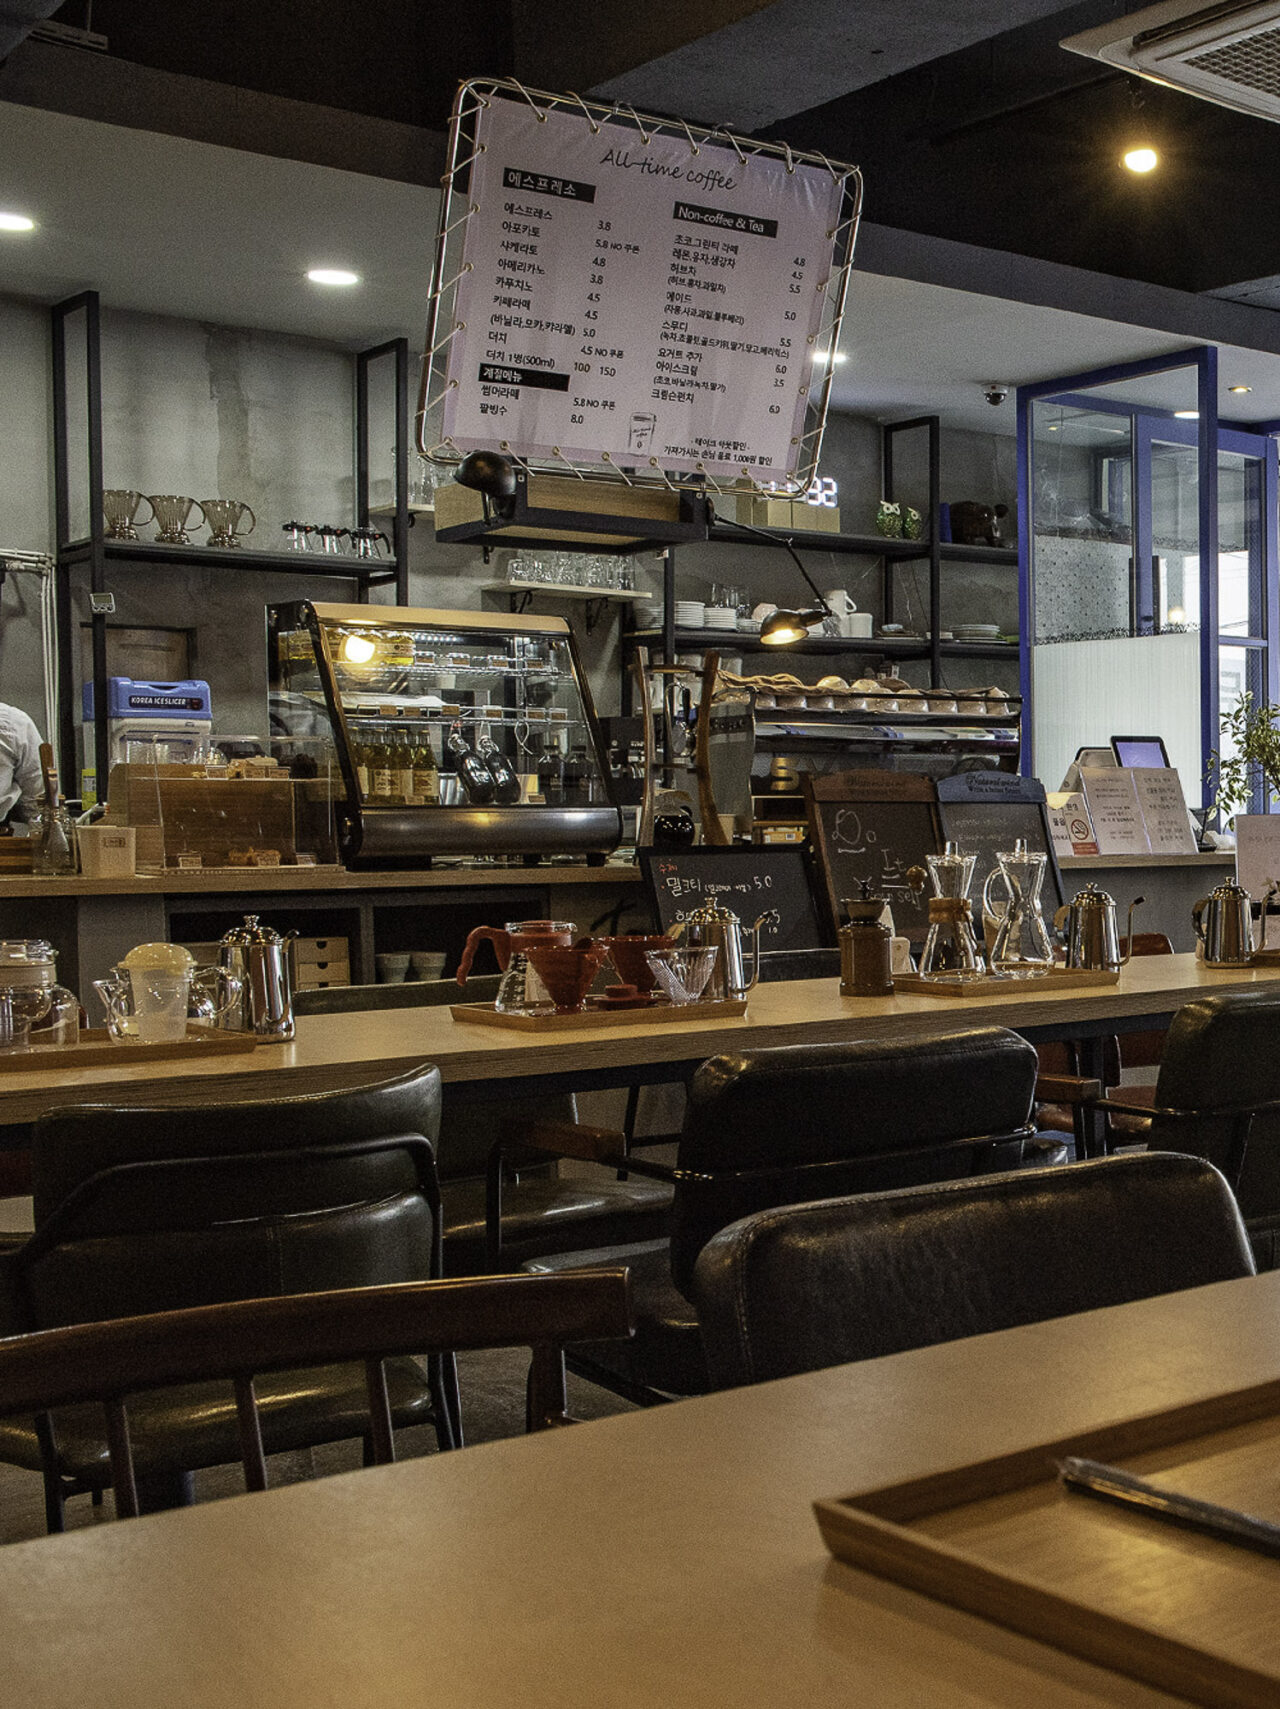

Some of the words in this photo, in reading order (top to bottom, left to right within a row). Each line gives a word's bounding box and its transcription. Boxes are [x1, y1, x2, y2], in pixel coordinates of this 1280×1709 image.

[508, 171, 577, 197] 에스프레소
[686, 170, 737, 191] coffee
[597, 220, 612, 232] 3.8
[678, 206, 734, 228] Non-coffee
[735, 217, 747, 230] &
[749, 219, 765, 234] Tea
[595, 238, 608, 249] 5.8
[610, 242, 623, 251] NO
[498, 258, 546, 276] 아메리카노
[589, 273, 604, 285] 3.8
[592, 256, 606, 268] 4.8
[793, 256, 806, 268] 4.8
[670, 262, 697, 277] 허브차
[788, 283, 801, 294] 5.5
[791, 271, 804, 281] 4.5
[495, 276, 534, 293] 카푸치노
[587, 292, 601, 303] 4.5
[584, 310, 599, 321] 4.5
[666, 290, 693, 304] 에이드
[784, 310, 797, 322] 5.0
[582, 328, 596, 338] 5.0
[661, 319, 689, 333] 스무디
[779, 337, 792, 348] 5.5
[488, 331, 508, 345] 더치
[580, 345, 593, 356] 4.5
[594, 347, 608, 357] NO
[486, 349, 505, 362] 더치
[658, 347, 685, 361] 요거트
[685, 351, 703, 363] 추가
[775, 364, 788, 375] 6.0
[655, 360, 699, 377] 아이스크림
[773, 378, 786, 388] 3.5
[479, 402, 508, 416] 팔빙수
[570, 414, 584, 424] 8.0
[573, 397, 586, 408] 5.8
[586, 399, 600, 409] NO
[131, 696, 153, 704] KOREA
[666, 876, 700, 897] 밀크티
